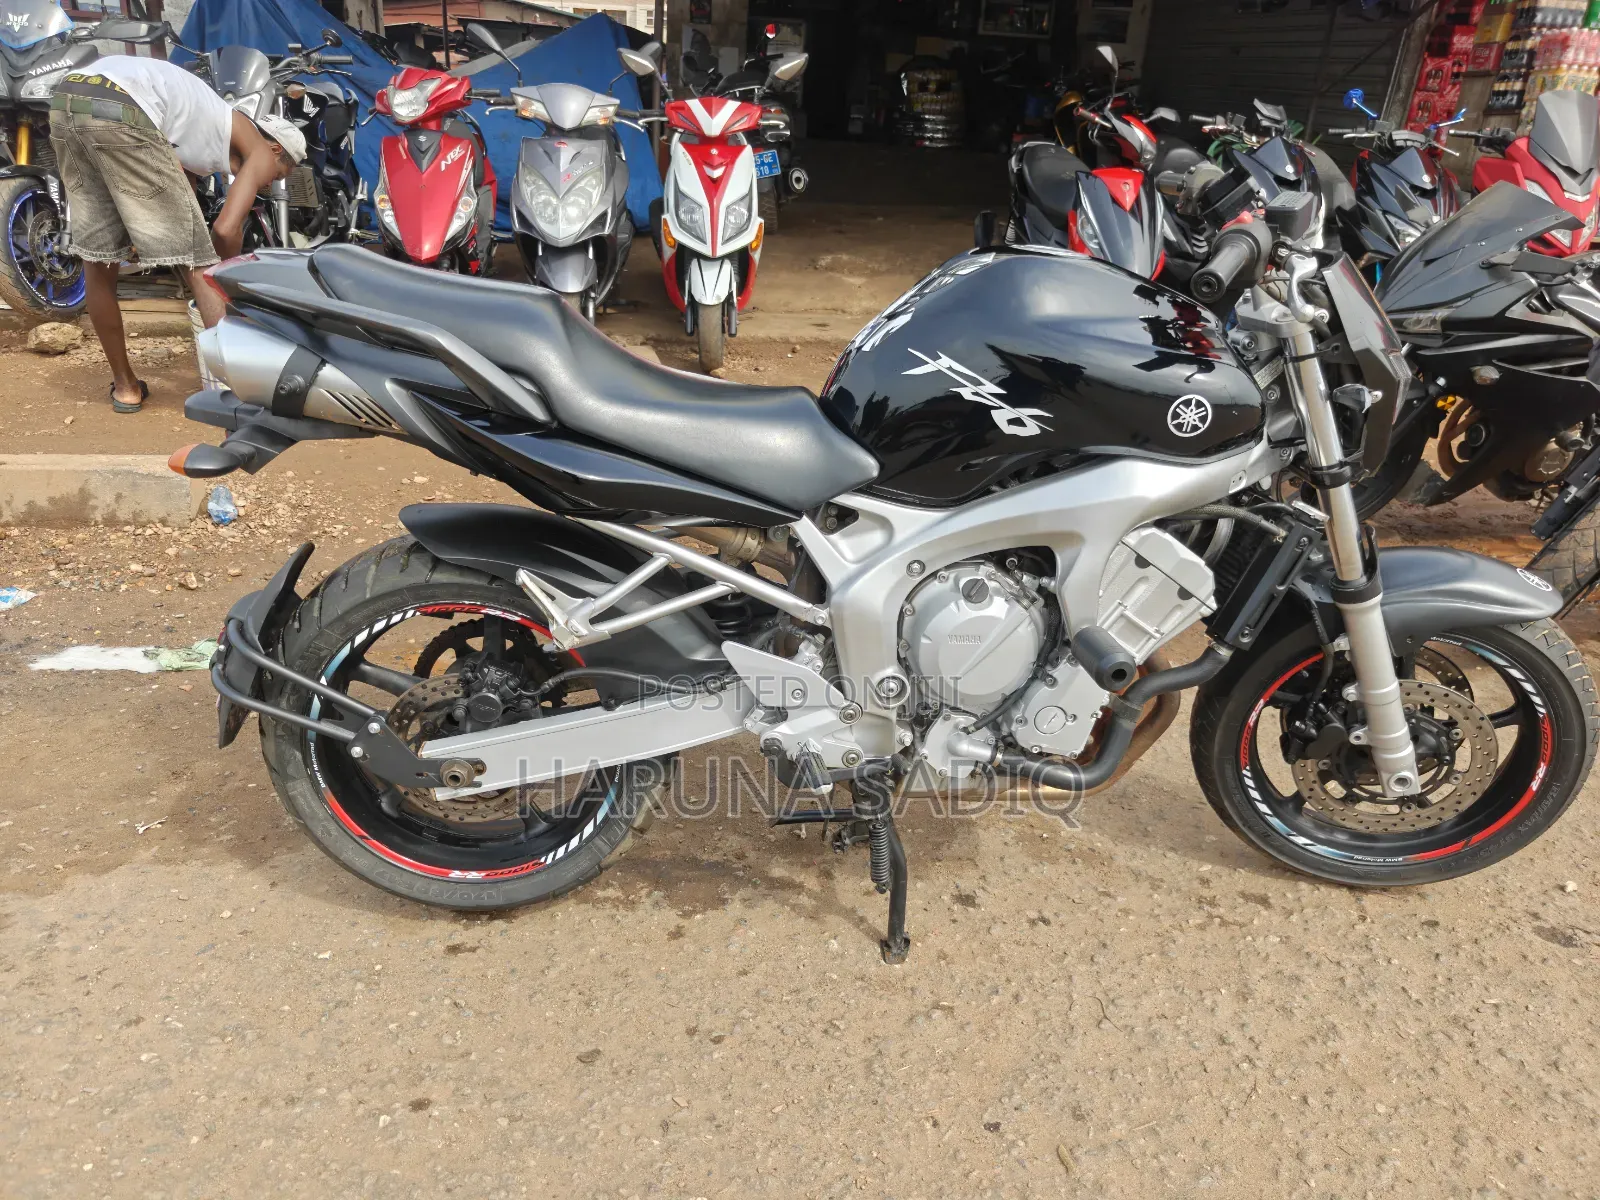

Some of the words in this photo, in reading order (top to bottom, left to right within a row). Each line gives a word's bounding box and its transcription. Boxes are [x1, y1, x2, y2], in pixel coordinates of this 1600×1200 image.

[29, 59, 74, 76] YAMAHA
[755, 152, 774, 165] 5-GE
[948, 634, 982, 645] YAMAHA
[309, 741, 319, 771] Motorrad
[315, 771, 326, 788] BMW
